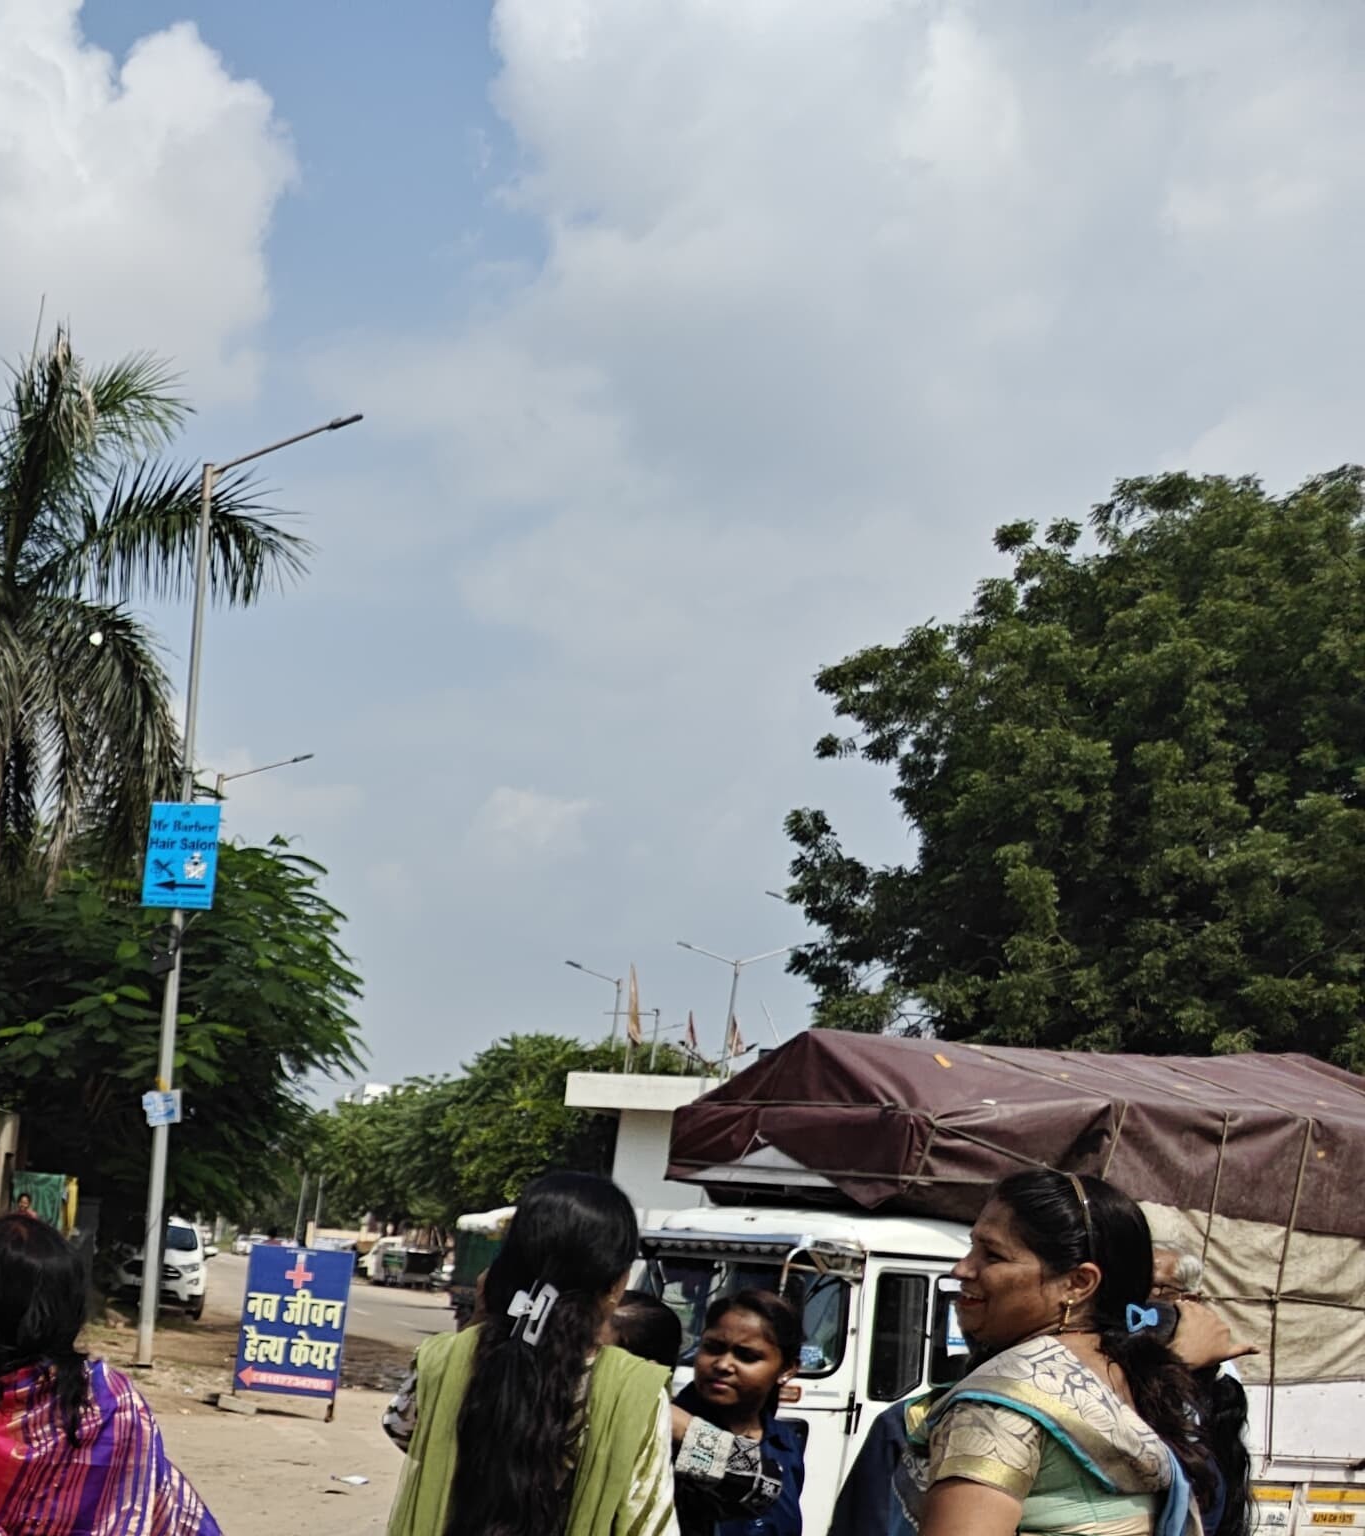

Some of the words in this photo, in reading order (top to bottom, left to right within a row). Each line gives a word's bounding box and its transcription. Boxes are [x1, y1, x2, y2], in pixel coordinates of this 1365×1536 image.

[173, 820, 215, 833] Barber
[149, 838, 177, 850] Hair
[180, 838, 216, 850] Salon
[247, 1292, 281, 1322] नव
[283, 1289, 346, 1330] जीवन
[290, 1330, 340, 1371] केयर
